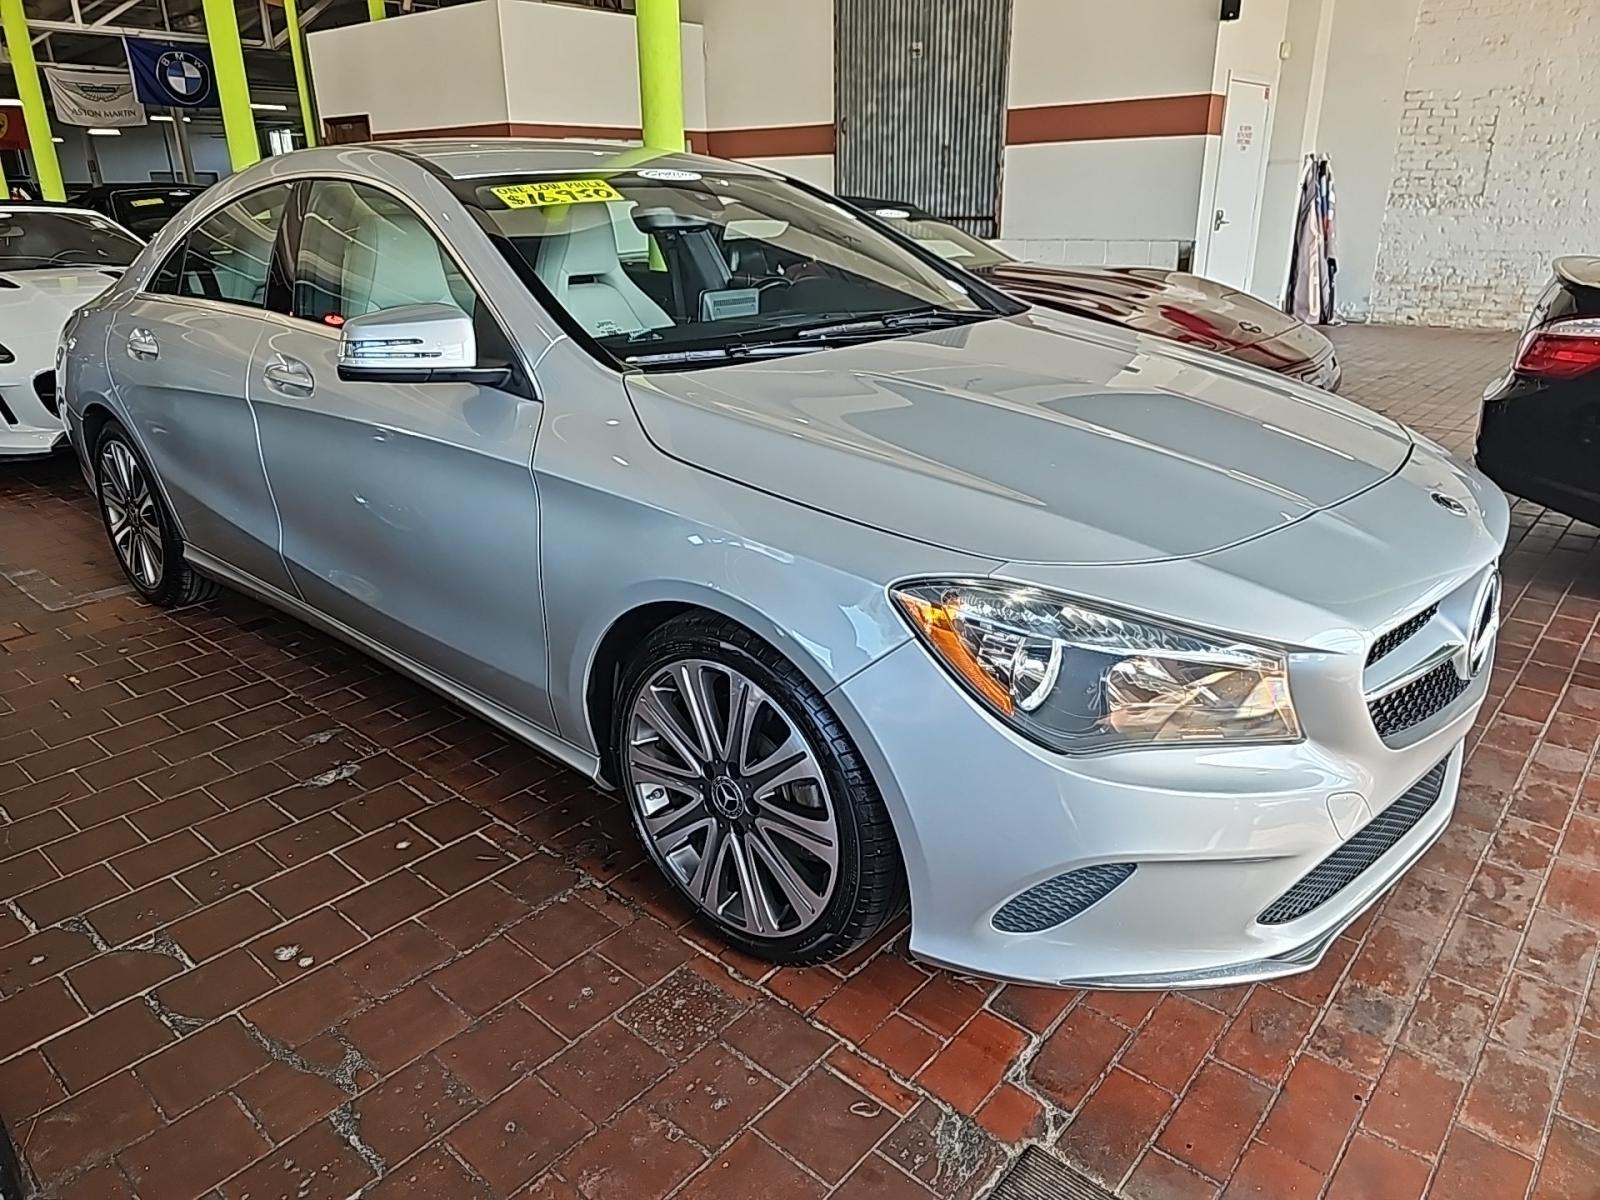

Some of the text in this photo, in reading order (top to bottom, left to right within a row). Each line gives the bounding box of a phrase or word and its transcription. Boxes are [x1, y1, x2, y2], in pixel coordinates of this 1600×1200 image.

[103, 109, 136, 118] MARTIN
[496, 180, 605, 195] ONE LOW PRICE
